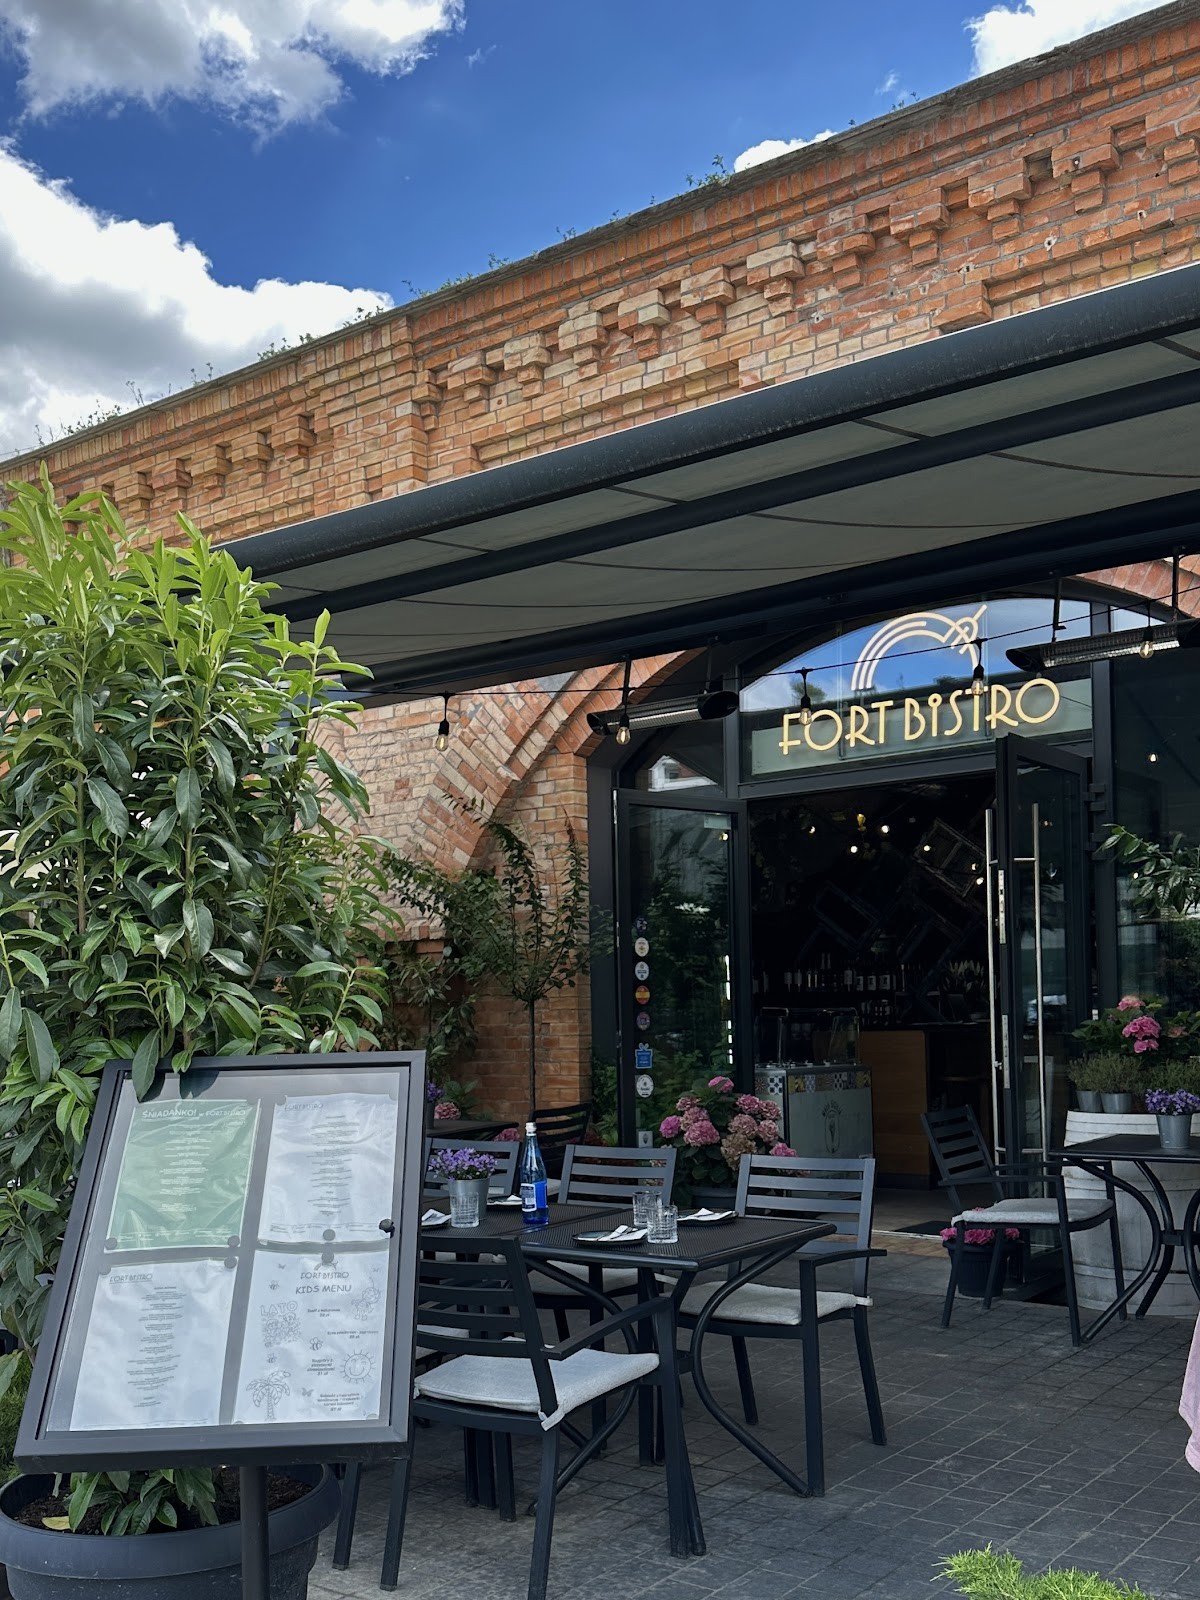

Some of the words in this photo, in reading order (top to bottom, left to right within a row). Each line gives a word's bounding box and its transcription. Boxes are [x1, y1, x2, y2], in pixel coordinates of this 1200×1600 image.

[778, 700, 894, 755] FORT
[142, 1108, 197, 1119] ŚNIADANKO!
[295, 1285, 320, 1295] KIDS
[322, 1284, 352, 1293] MENU
[260, 1300, 299, 1317] LATO
